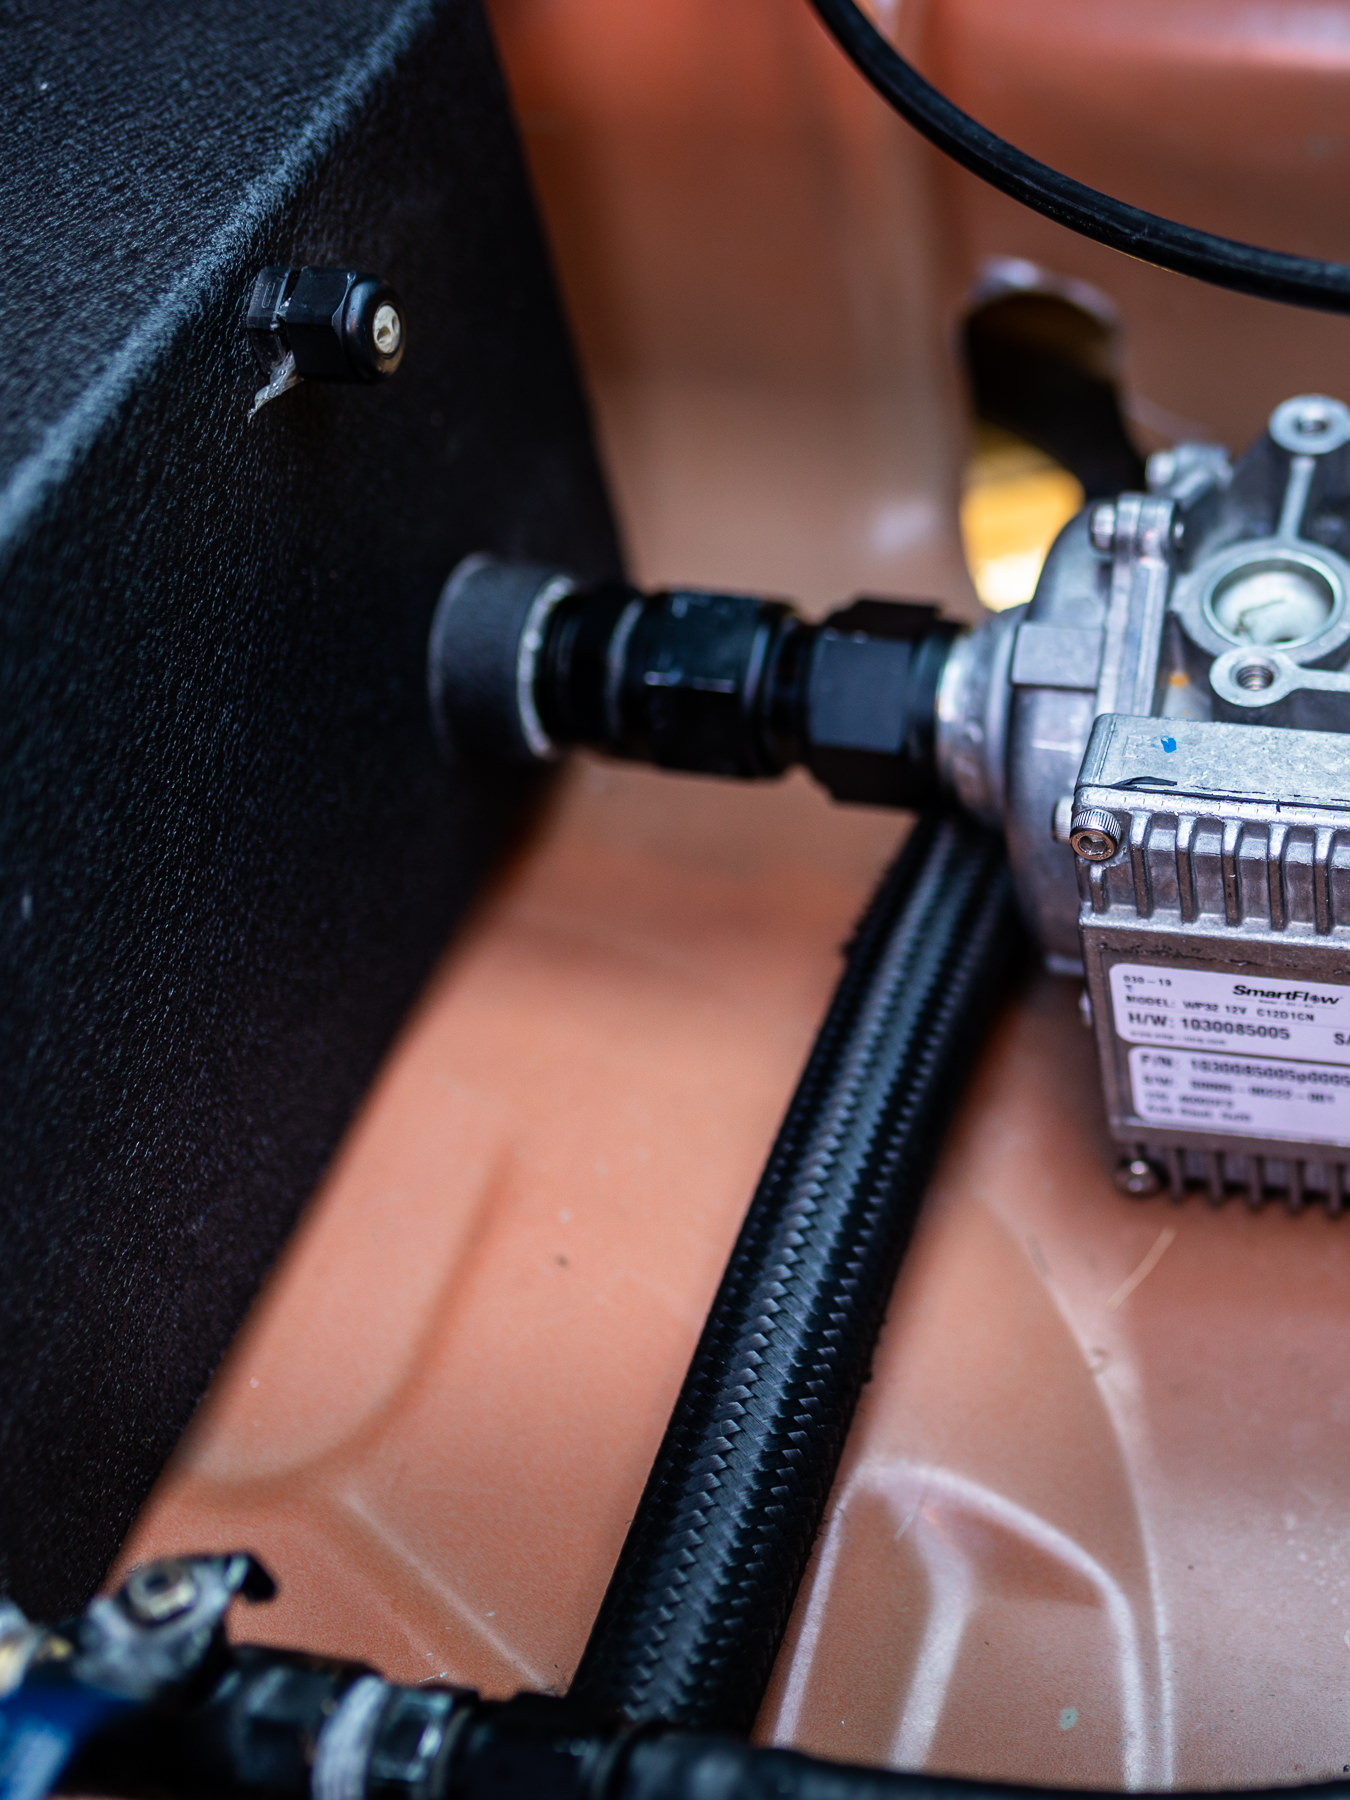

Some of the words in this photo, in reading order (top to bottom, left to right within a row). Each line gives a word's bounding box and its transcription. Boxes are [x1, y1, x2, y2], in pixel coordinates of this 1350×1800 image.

[1126, 995, 1176, 1008] MODEL:
[1226, 1005, 1247, 1015] 12V
[1232, 985, 1340, 1005] SmartFlow
[1128, 1012, 1175, 1028] H/W:
[1181, 1017, 1291, 1040] 1030085005
